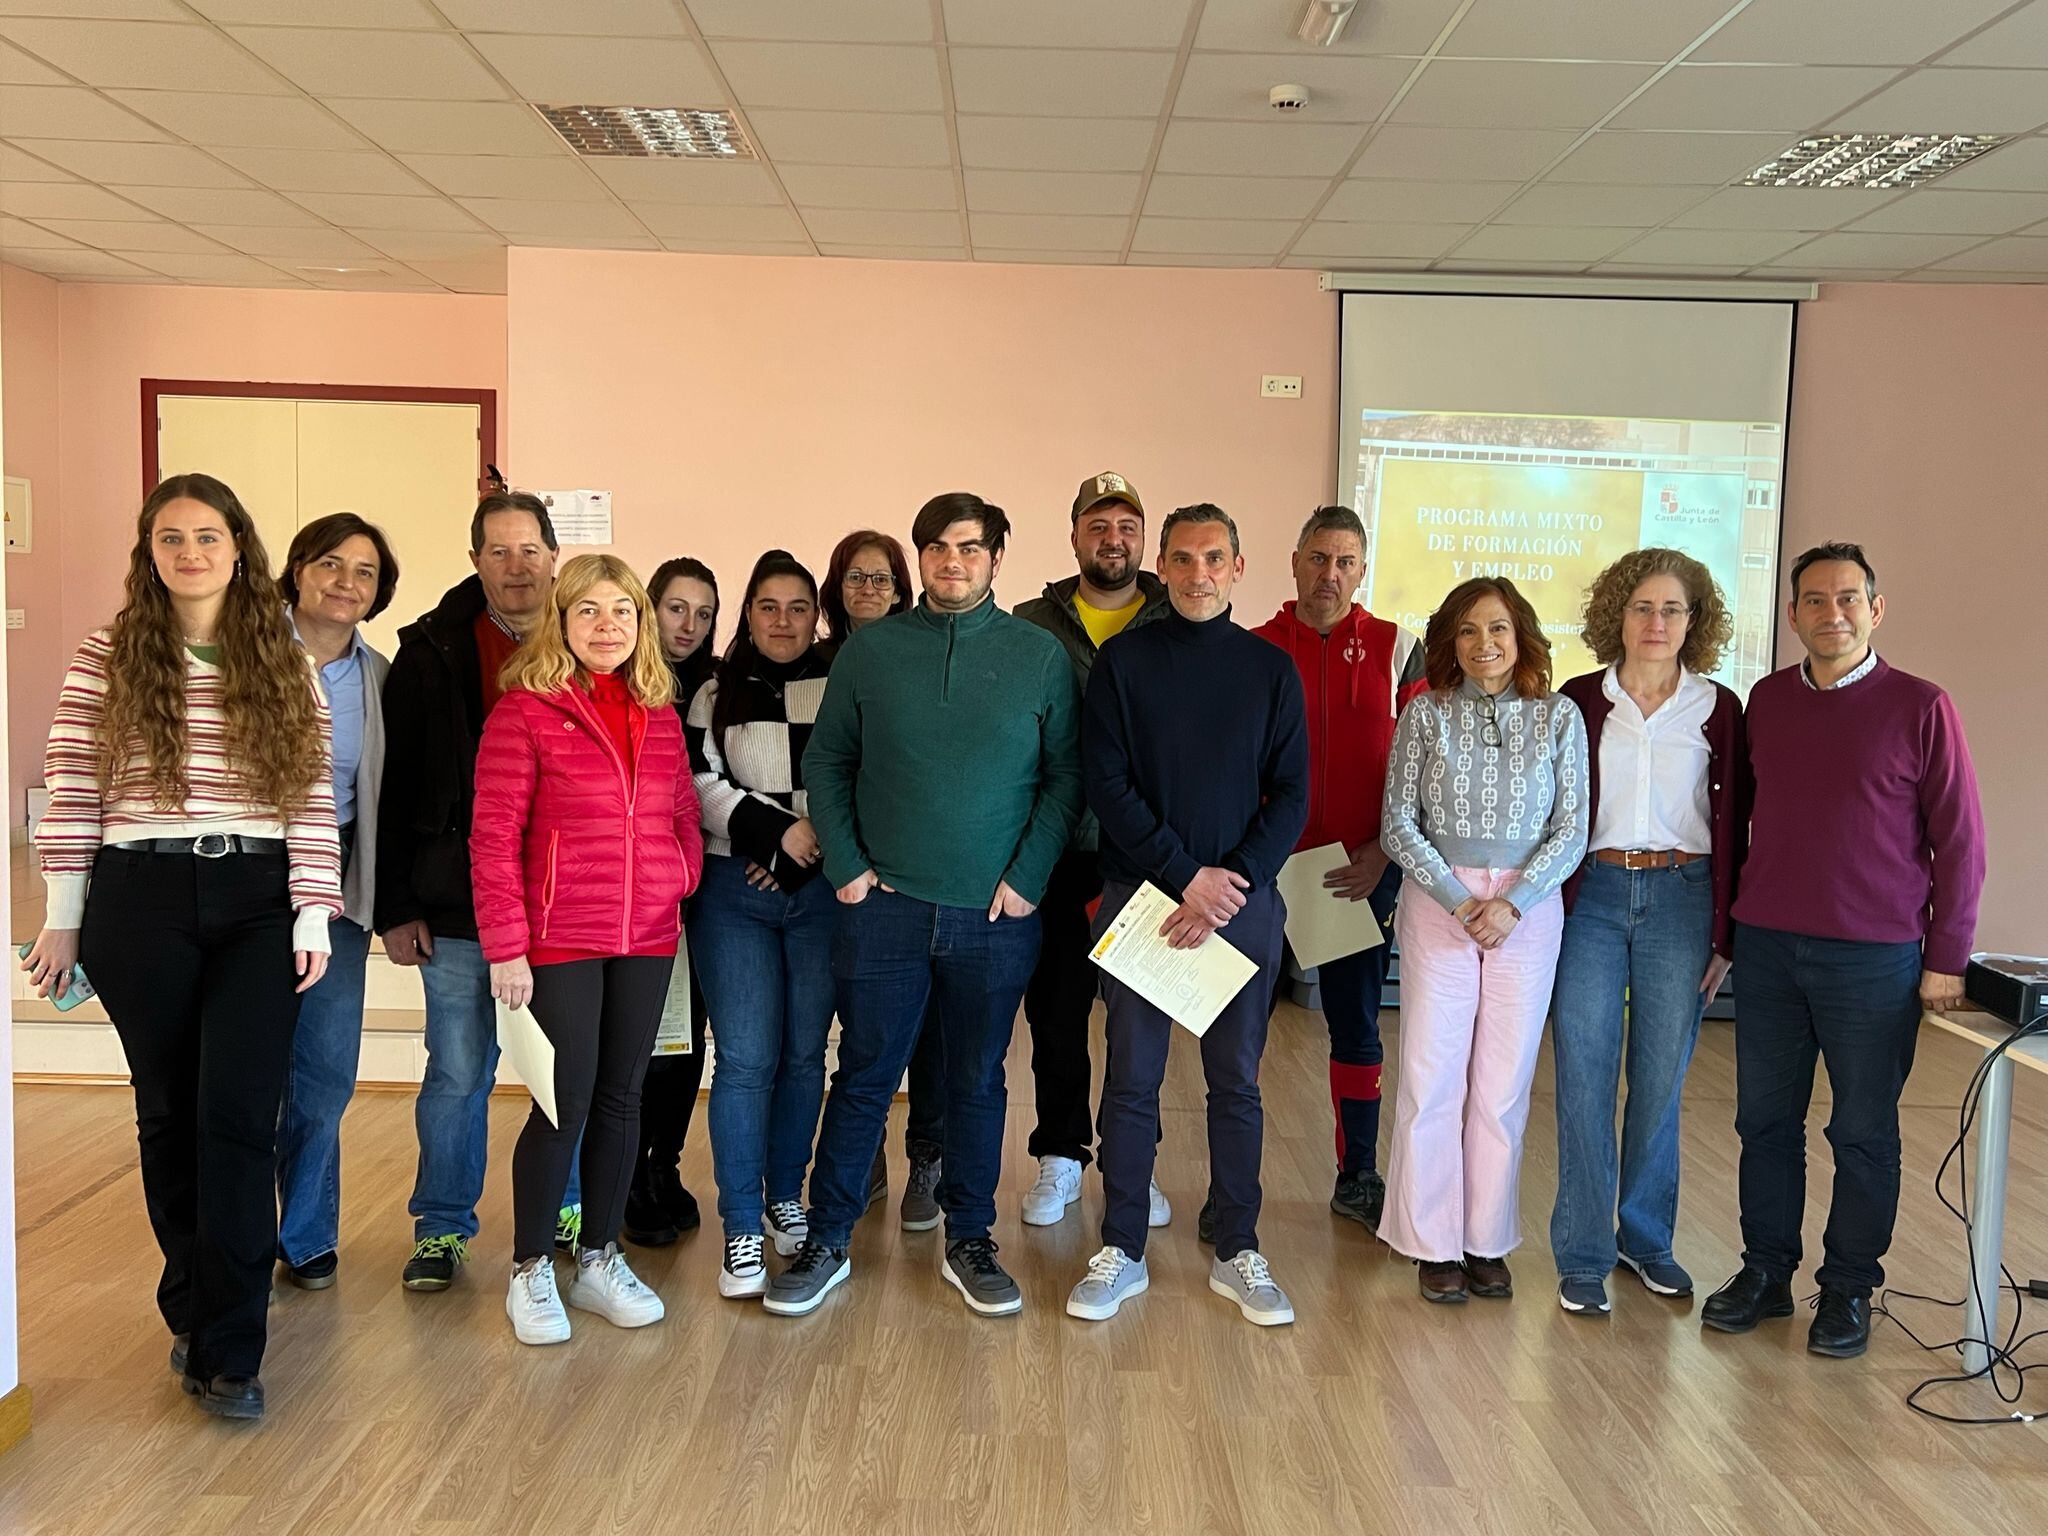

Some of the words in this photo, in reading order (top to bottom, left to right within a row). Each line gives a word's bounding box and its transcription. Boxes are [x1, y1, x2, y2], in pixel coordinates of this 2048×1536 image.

[1416, 506, 1529, 527] PROGRAMA
[1537, 511, 1603, 532] MIXTO
[1655, 514, 1687, 522] Castilla
[1697, 516, 1720, 524] León
[1680, 507, 1705, 515] Junta
[1428, 532, 1456, 552] DE
[1463, 534, 1582, 557] FORMACIÓN
[1452, 560, 1464, 578] Y
[1471, 561, 1553, 582] EMPLEO
